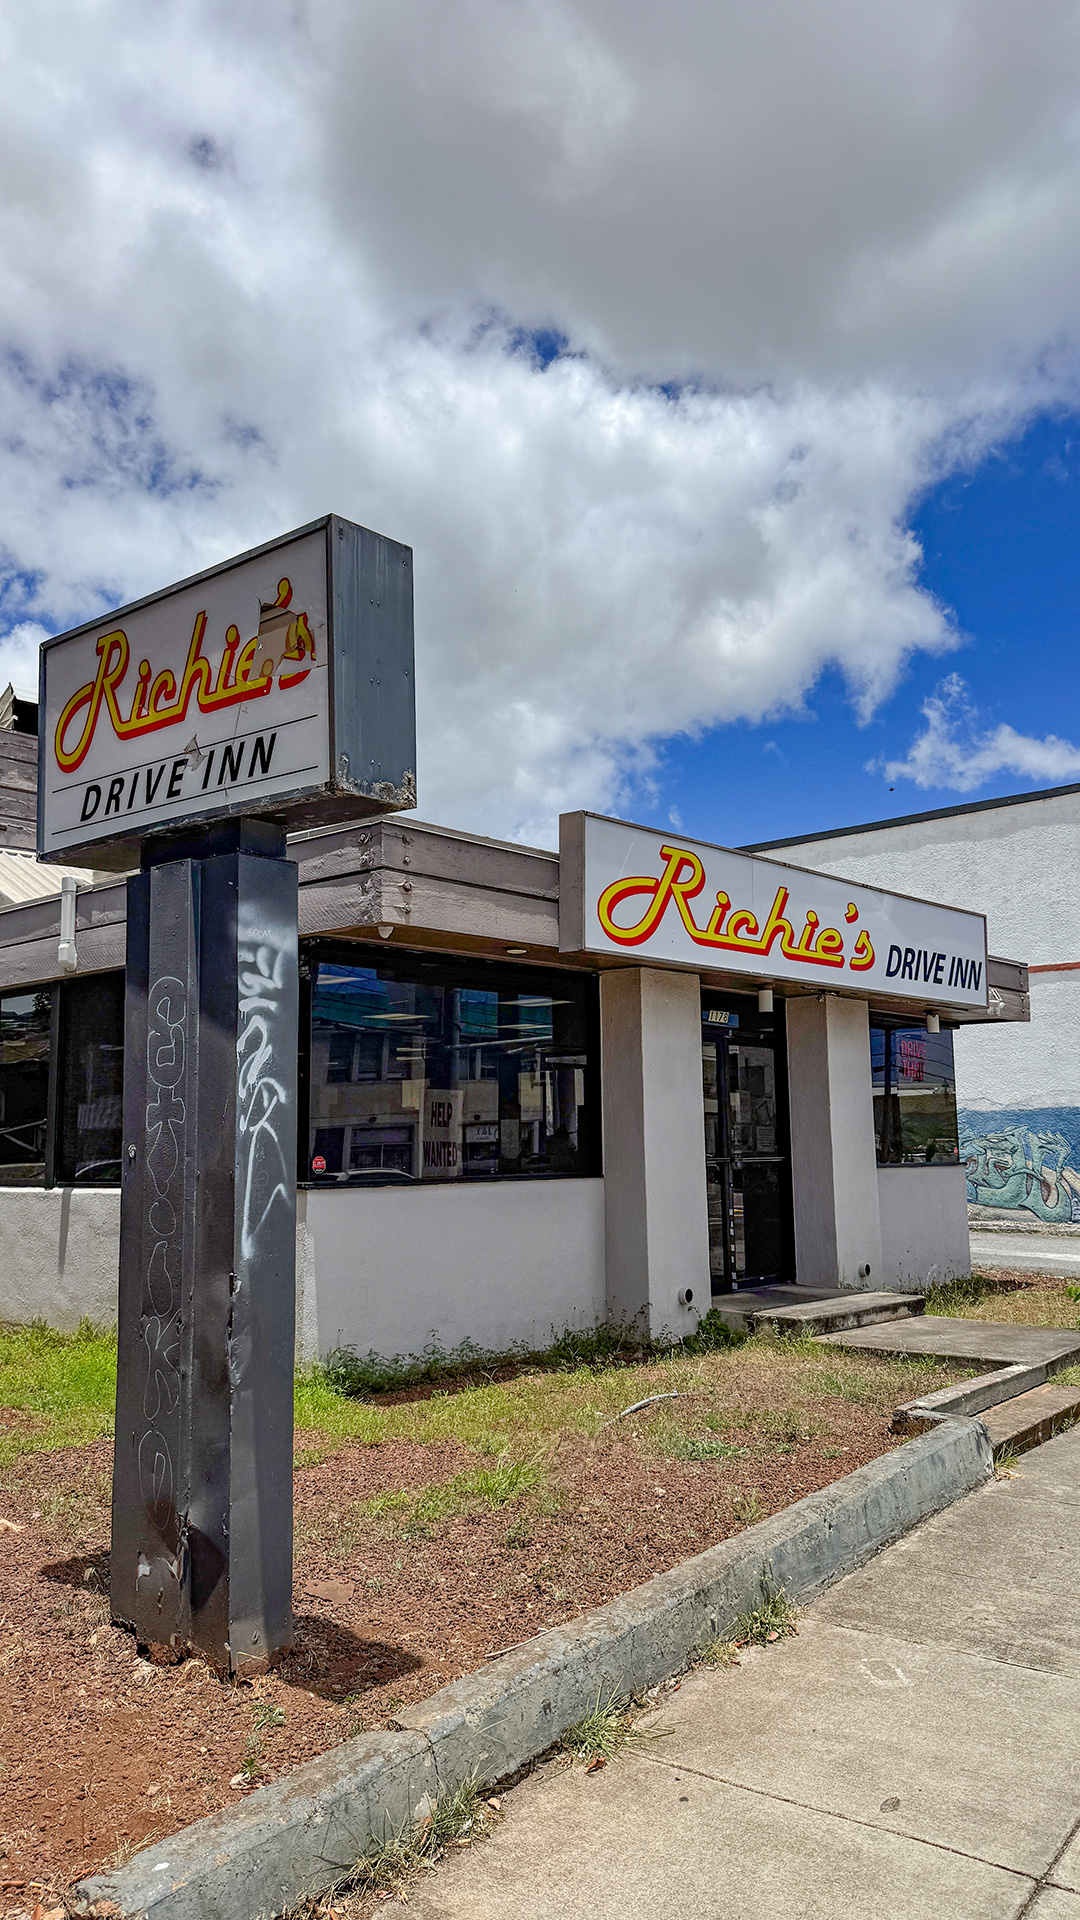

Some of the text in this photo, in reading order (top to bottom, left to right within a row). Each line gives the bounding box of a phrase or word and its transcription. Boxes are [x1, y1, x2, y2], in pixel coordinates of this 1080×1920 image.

[80, 732, 278, 822] DRIVE INN
[597, 844, 876, 971] Richie's
[886, 944, 983, 991] DRIVE INN
[709, 1011, 729, 1023] 1178
[900, 1040, 927, 1059] DRIVE
[901, 1059, 926, 1081] THRU
[430, 1101, 453, 1128] HELP
[422, 1141, 458, 1168] WANTED
